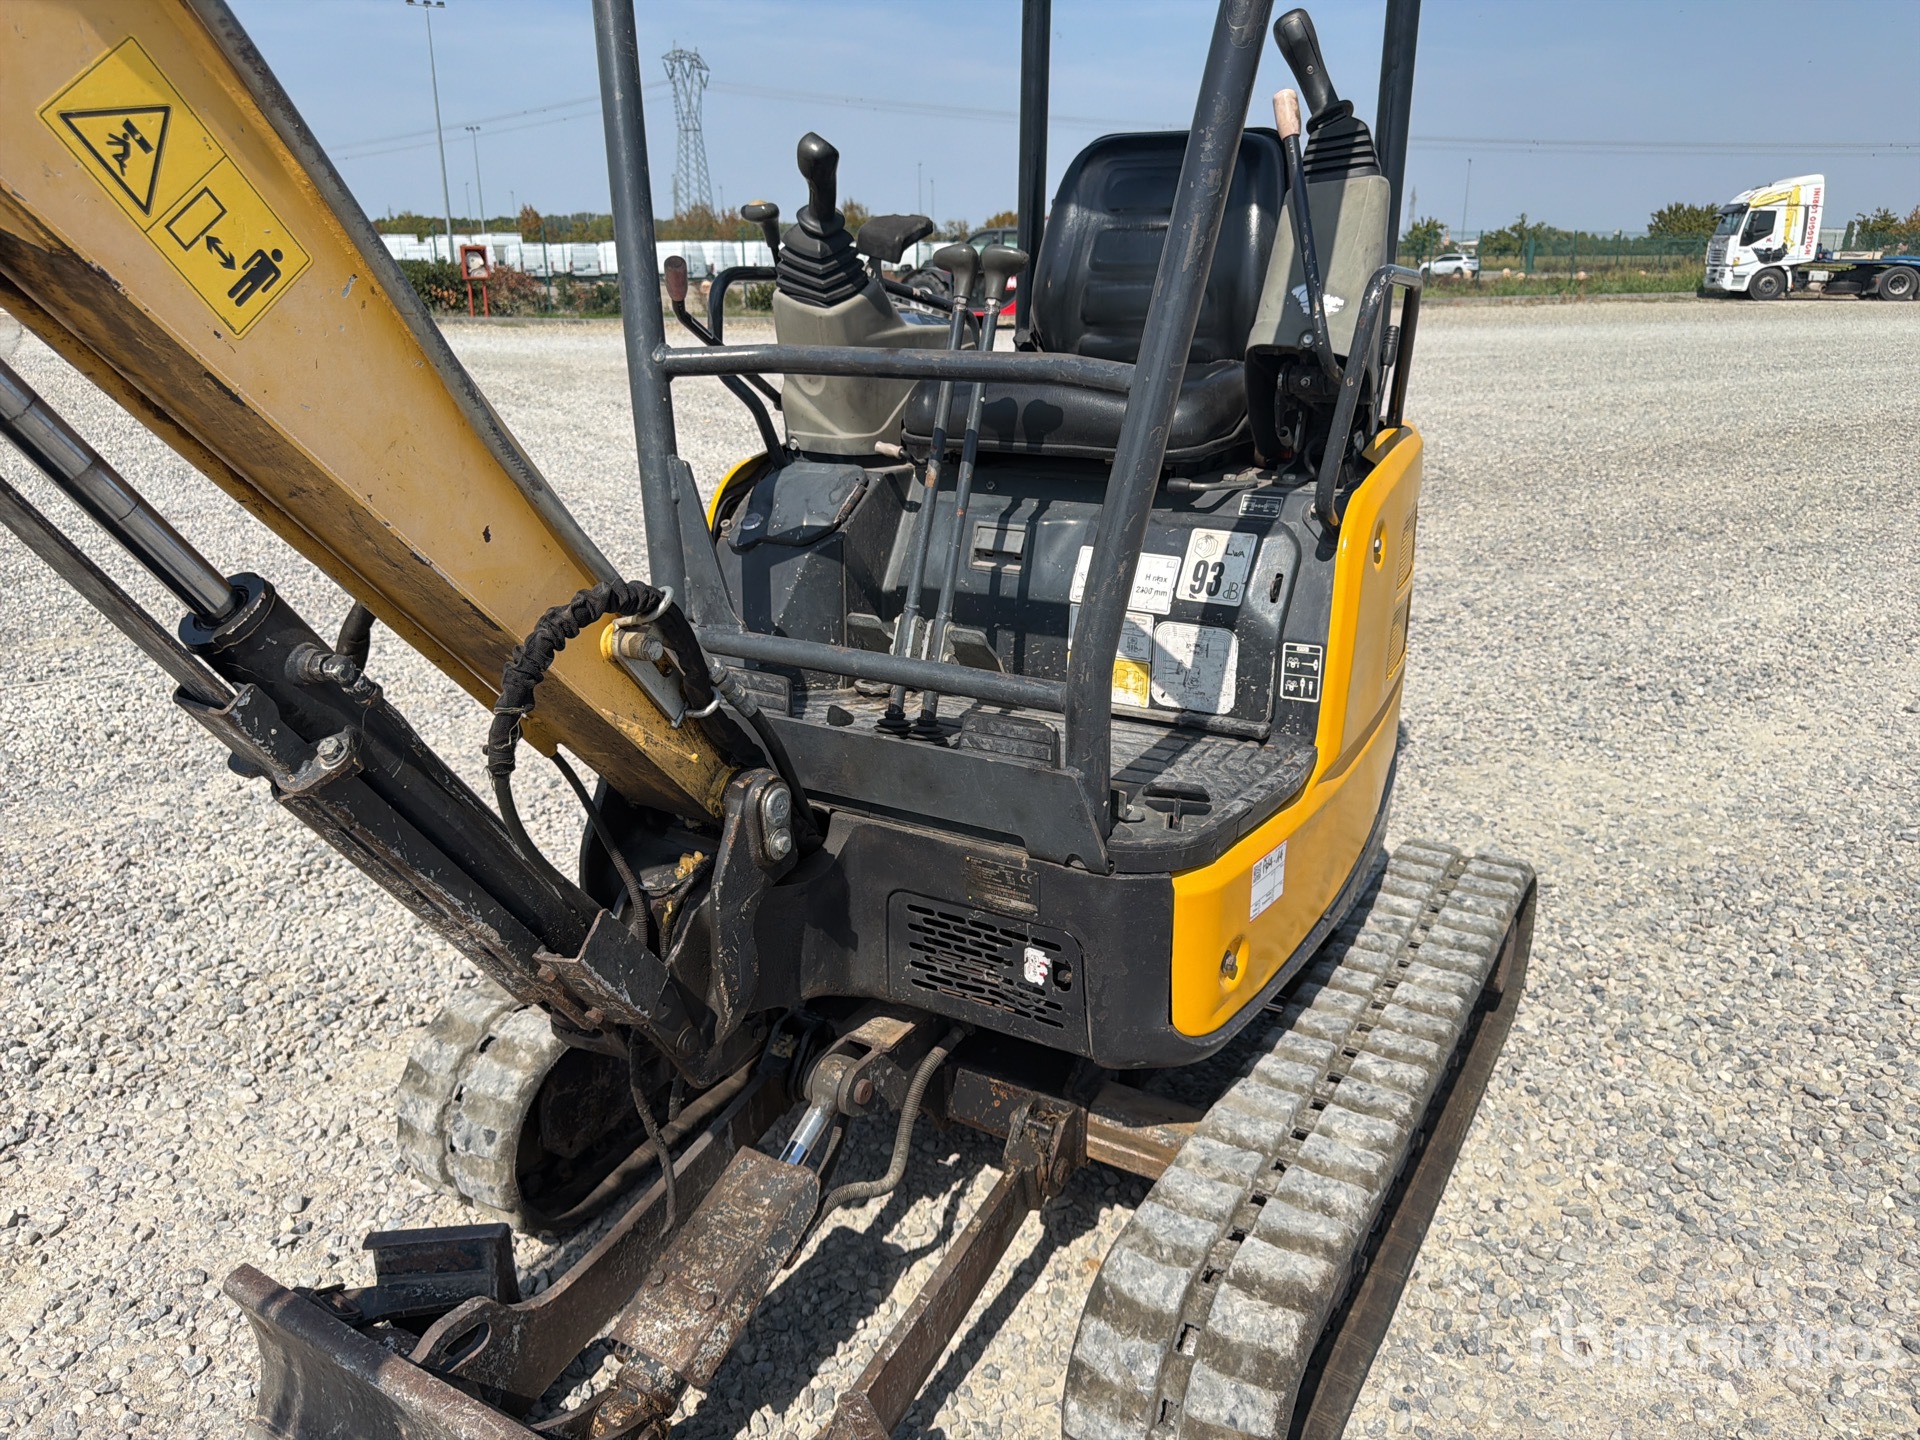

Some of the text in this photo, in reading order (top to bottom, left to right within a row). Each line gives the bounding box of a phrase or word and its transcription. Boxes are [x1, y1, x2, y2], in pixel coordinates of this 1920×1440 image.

[1805, 187, 1821, 255] NOLEGGIO LORINI
[1145, 573, 1152, 581] H
[1190, 560, 1225, 597] 93
[1154, 589, 1168, 597] mm
[1222, 582, 1238, 600] dB
[1020, 873, 1033, 884] CE
